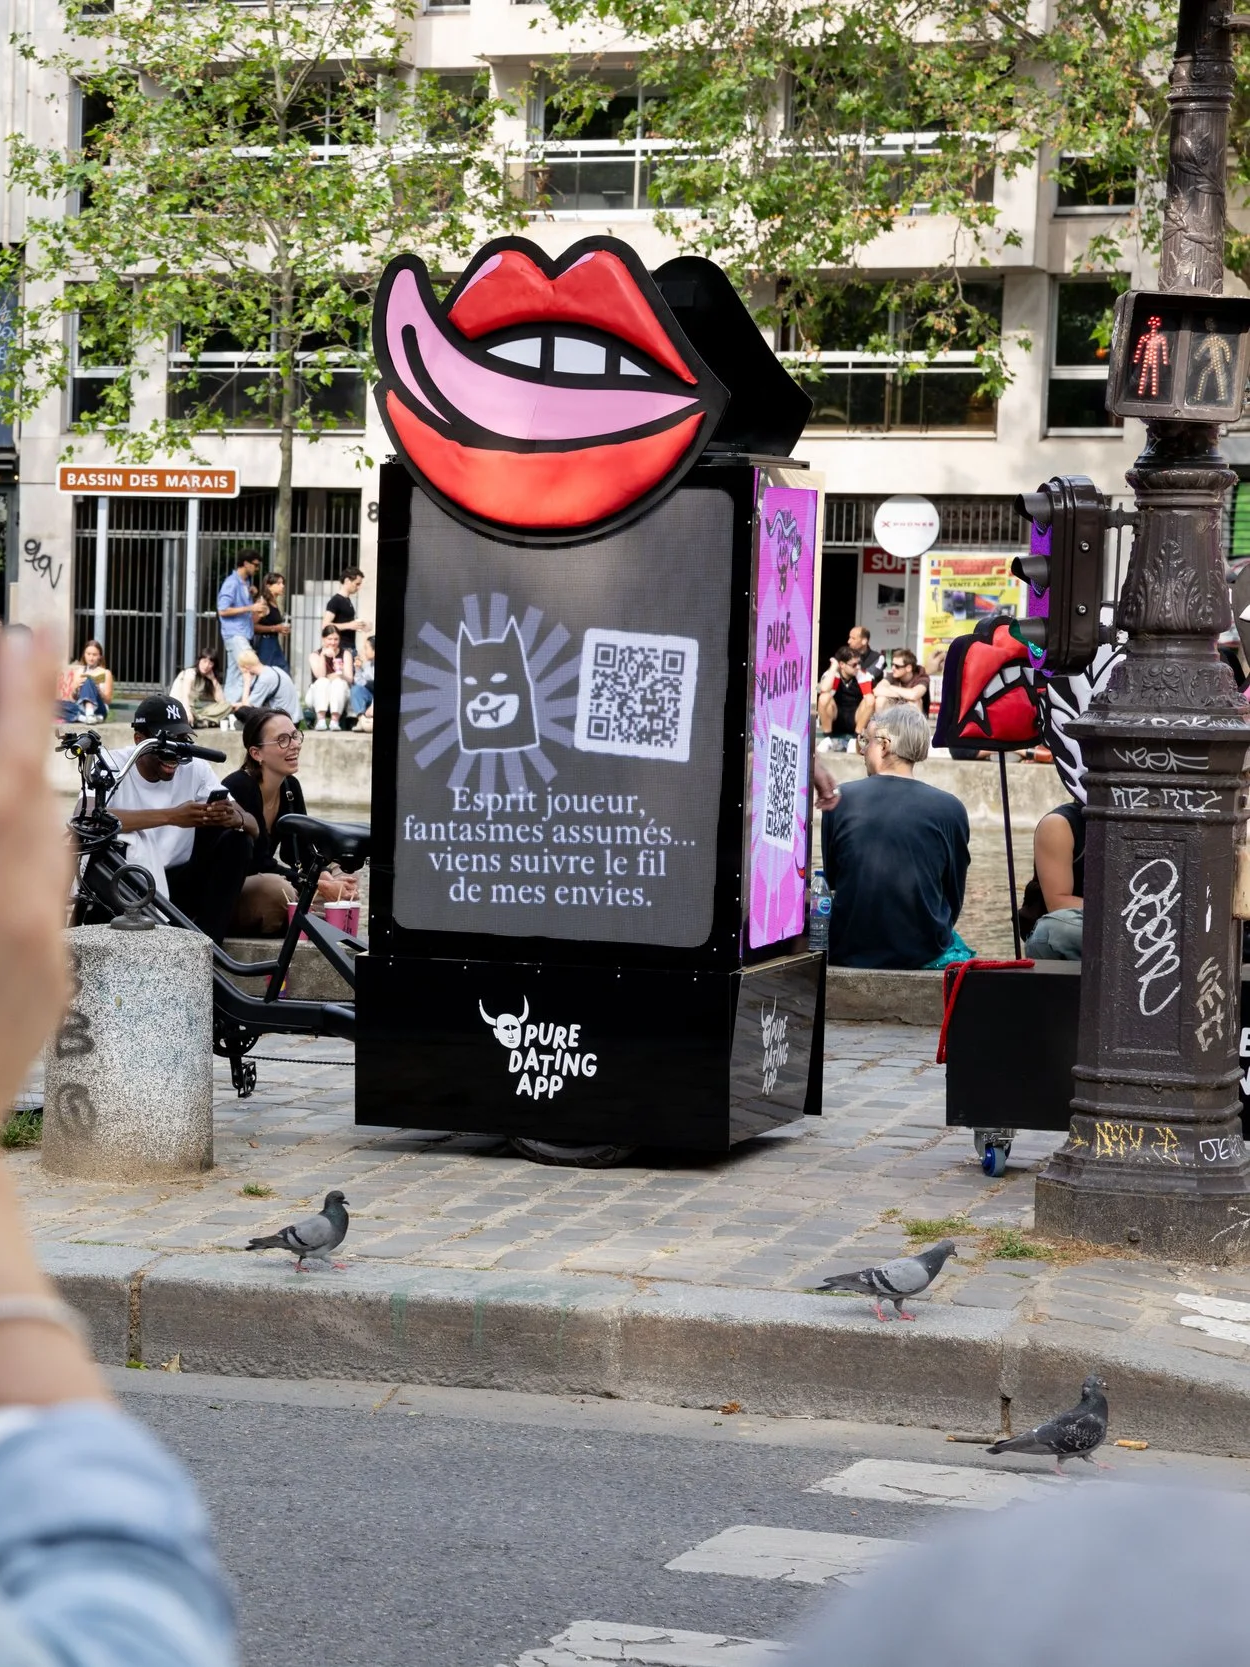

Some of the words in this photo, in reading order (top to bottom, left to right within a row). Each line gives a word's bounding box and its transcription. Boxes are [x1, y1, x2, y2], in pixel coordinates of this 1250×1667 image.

[66, 473, 123, 486] BASSIN
[129, 474, 158, 487] DES
[165, 474, 228, 488] MARAIS
[766, 611, 791, 659] PURE
[452, 786, 538, 821] Esprit
[541, 787, 646, 821] joueur,
[403, 814, 545, 843] fantasmes
[552, 818, 696, 846] assumés...
[428, 846, 502, 873] viens
[510, 847, 596, 875] suivre
[604, 848, 629, 876] le
[637, 849, 667, 877] fil
[449, 876, 482, 903] de
[490, 883, 546, 905] mes
[554, 880, 652, 907] envies.
[524, 1022, 581, 1050] PURE
[769, 1015, 789, 1045] PURE
[508, 1047, 598, 1077] DATING
[762, 1042, 789, 1073] DATING
[515, 1072, 564, 1100] APP
[761, 1068, 778, 1096] APP
